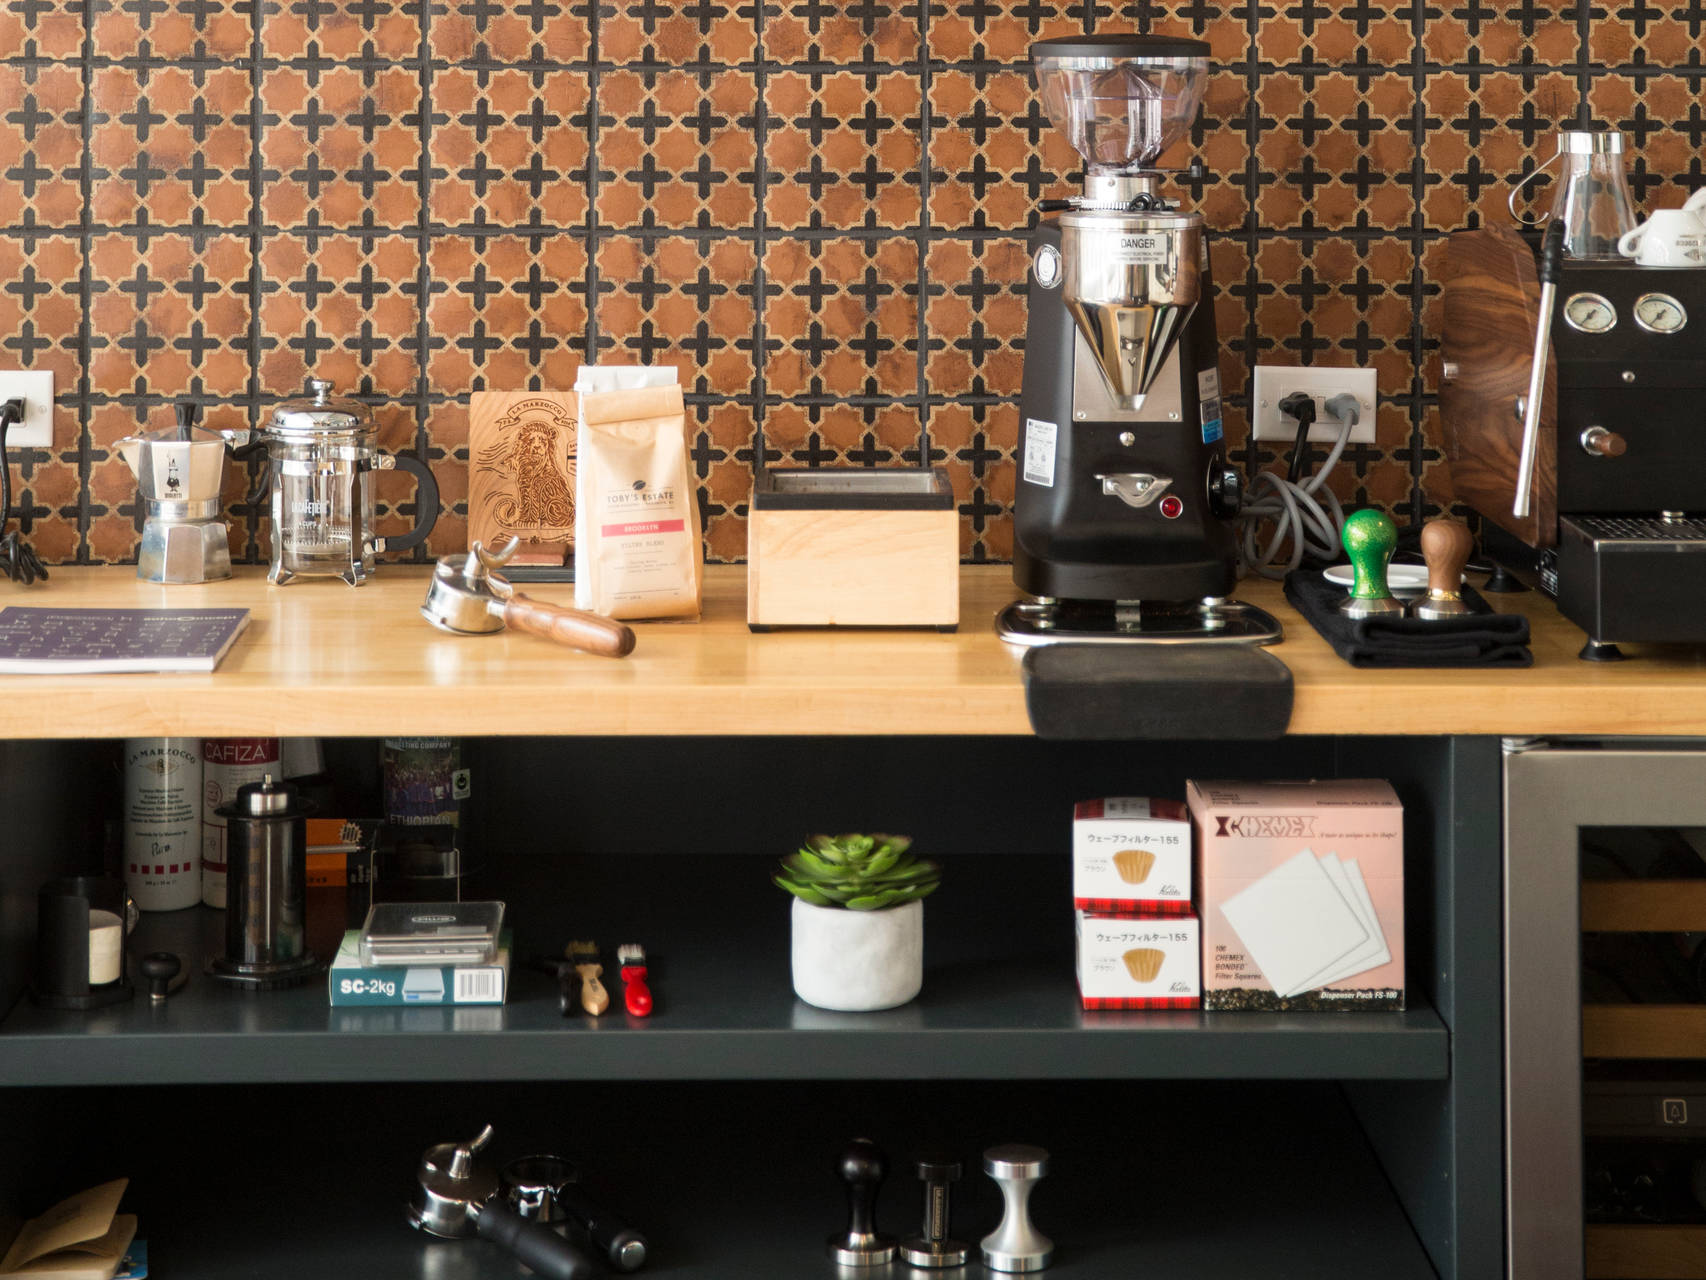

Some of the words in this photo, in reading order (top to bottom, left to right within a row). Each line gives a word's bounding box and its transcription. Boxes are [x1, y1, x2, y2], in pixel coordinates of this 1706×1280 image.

[1121, 238, 1155, 249] DANGER
[511, 406, 522, 415] LA
[523, 402, 562, 415] MARZOCCO
[606, 494, 639, 504] TOBY'S
[642, 491, 674, 501] ESTATE
[624, 524, 659, 533] BROOKLYN
[420, 740, 450, 749] COMPANY
[128, 754, 139, 766] LA
[139, 748, 196, 764] MARZOCCO
[205, 743, 266, 762] CAFIZA
[390, 815, 451, 826] ETHIOPIAN
[1230, 816, 1319, 838] CHEMEX
[1215, 972, 1233, 980] Filter
[1234, 972, 1262, 980] Squares
[340, 978, 396, 997] SC-2kg
[1320, 991, 1355, 1000] Dispenser
[1356, 991, 1373, 1000] Pack
[1374, 991, 1398, 1000] FS-100
